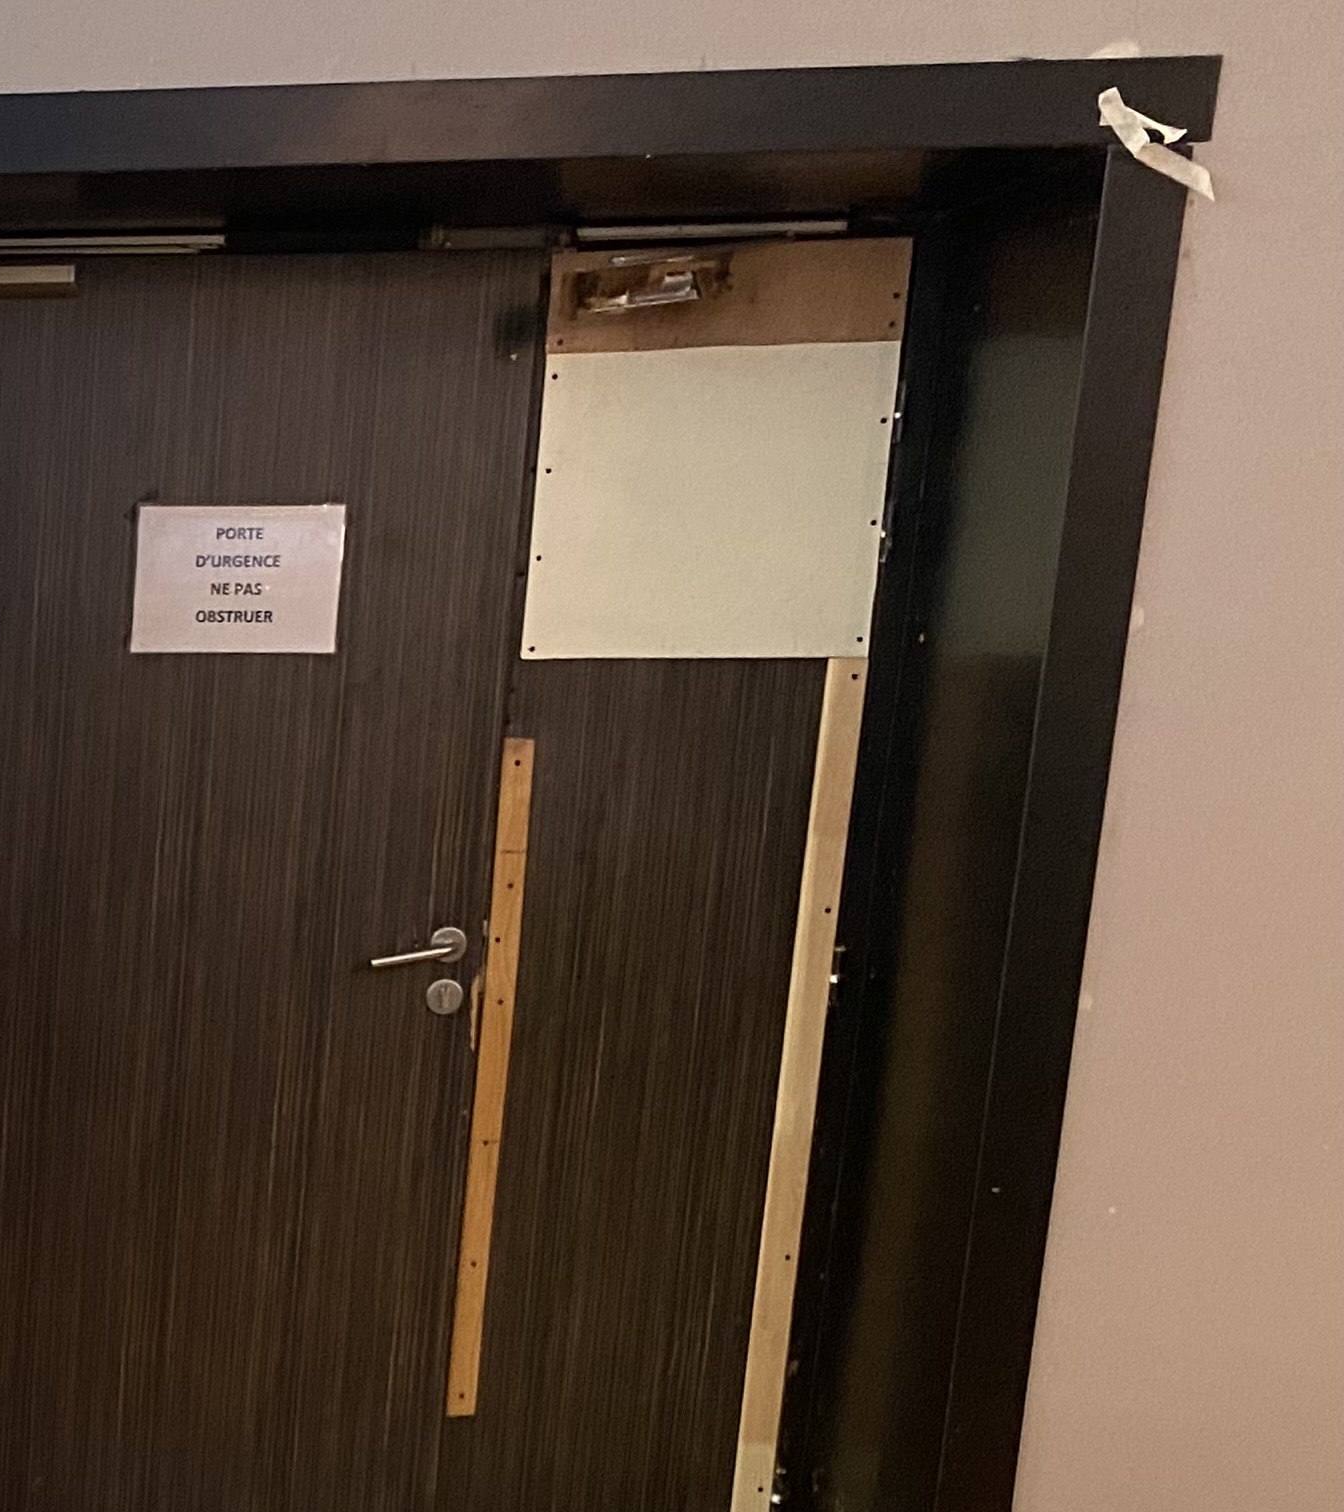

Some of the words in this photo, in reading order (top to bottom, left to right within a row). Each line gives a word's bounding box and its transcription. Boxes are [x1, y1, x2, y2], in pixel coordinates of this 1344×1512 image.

[216, 527, 264, 540] PORTE
[196, 554, 281, 568] D'URGENCE
[210, 583, 230, 595] NE
[234, 583, 262, 595] PAS
[195, 610, 273, 623] OBSTRUER
